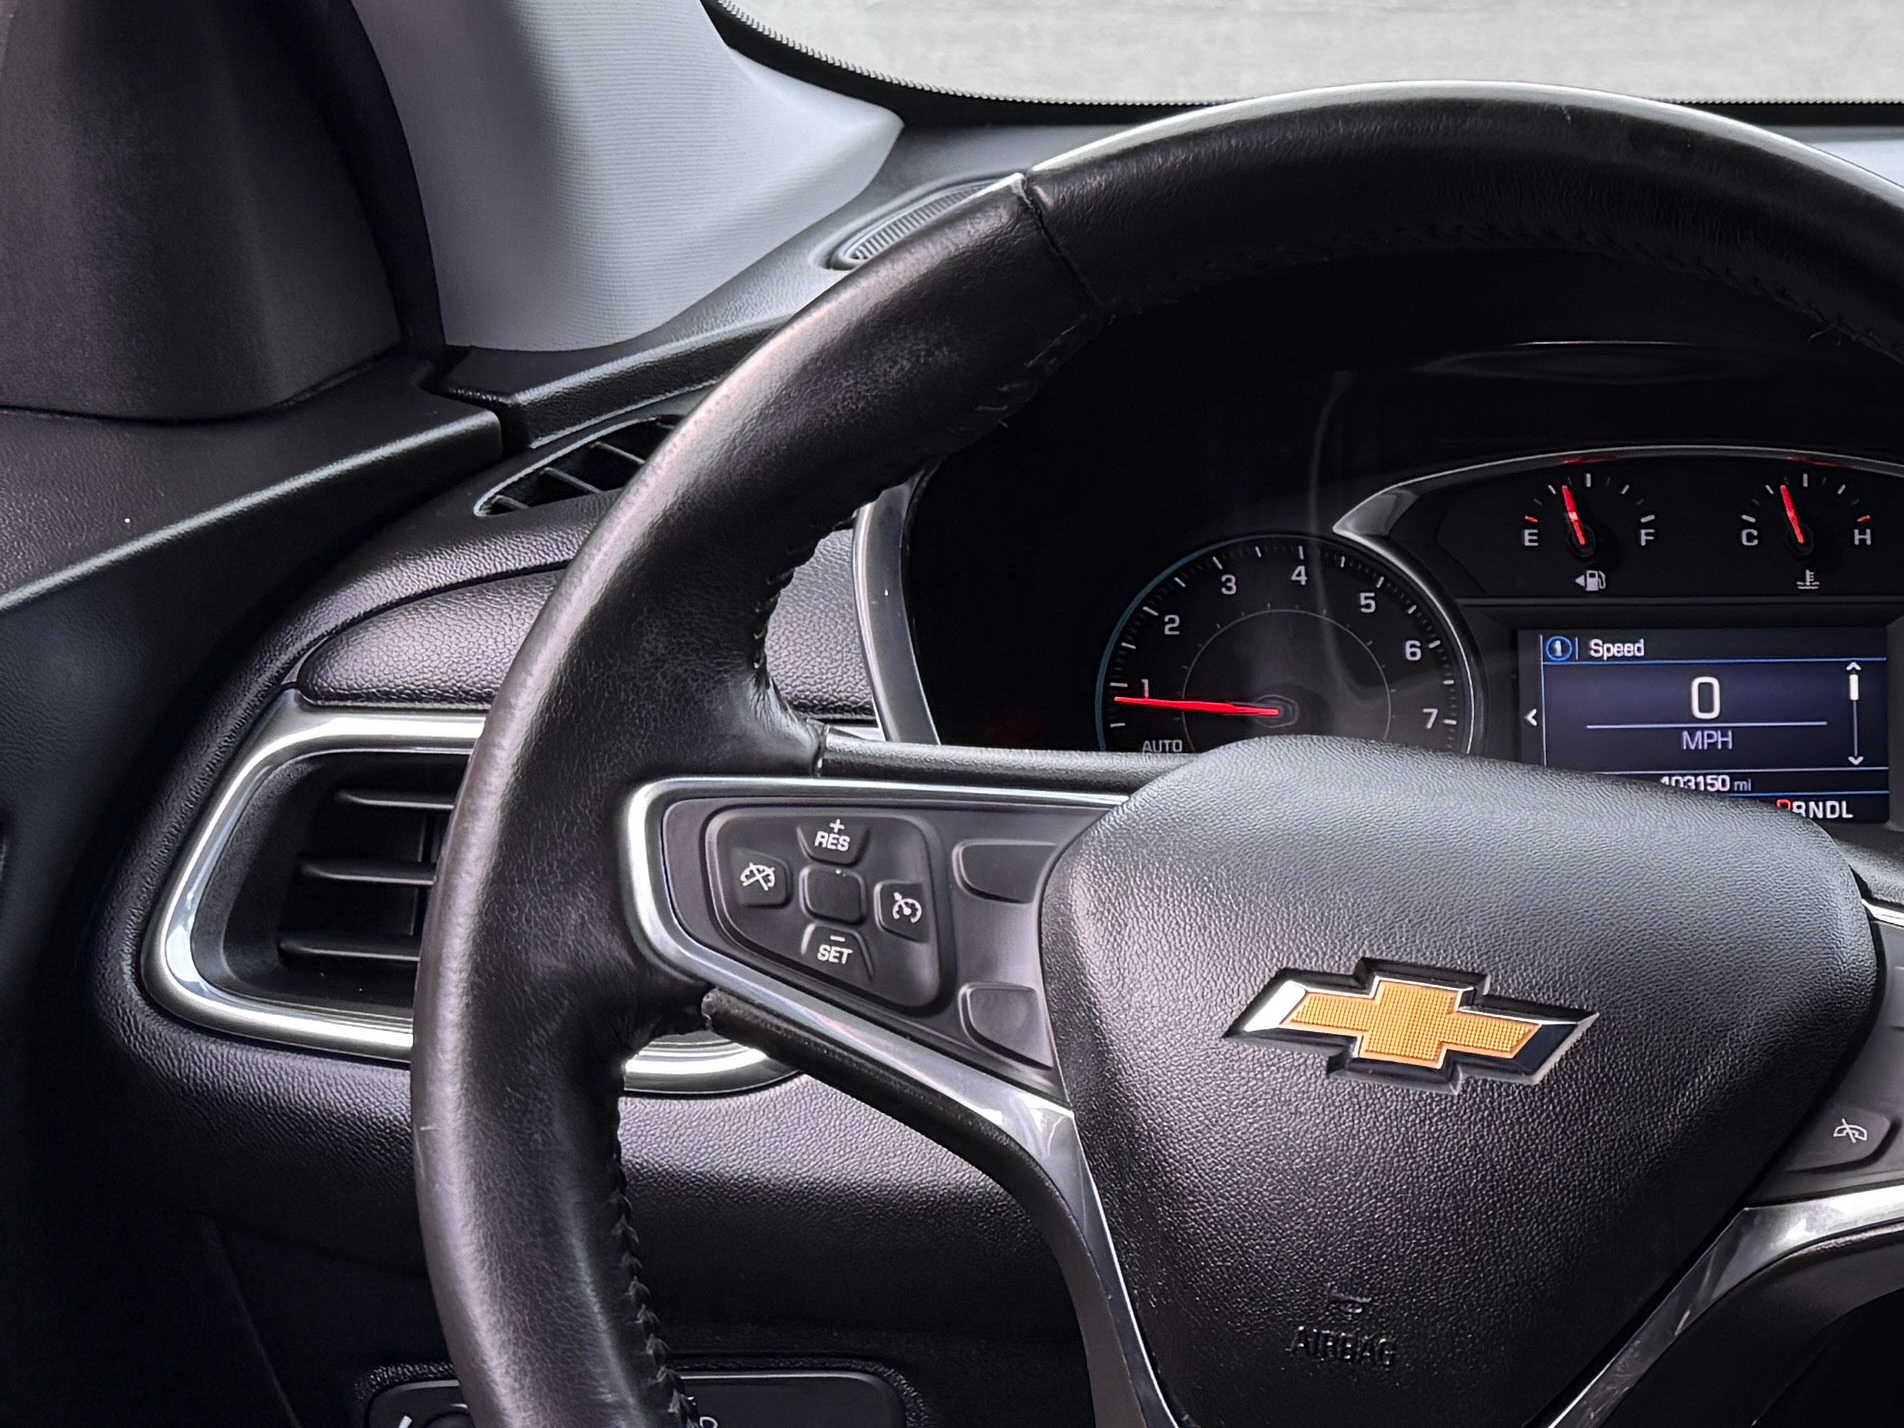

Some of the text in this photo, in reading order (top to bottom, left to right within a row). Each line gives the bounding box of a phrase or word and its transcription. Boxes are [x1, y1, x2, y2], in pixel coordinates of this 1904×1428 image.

[1523, 529, 1540, 547] E
[1640, 529, 1656, 546] F
[1741, 529, 1759, 546] C
[1854, 529, 1872, 546] H
[1220, 574, 1238, 596] 3
[1289, 564, 1308, 586] 4
[1359, 592, 1377, 614] 5
[1163, 614, 1181, 636] 2
[1404, 639, 1422, 662] 6
[1588, 637, 1646, 661] Speed
[1689, 675, 1722, 720] 0
[1421, 707, 1440, 730] 7
[1141, 739, 1184, 754] AUTO
[1680, 729, 1734, 751] MPH
[1733, 777, 1753, 792] mi
[813, 831, 851, 852] RES
[817, 943, 853, 965] SET
